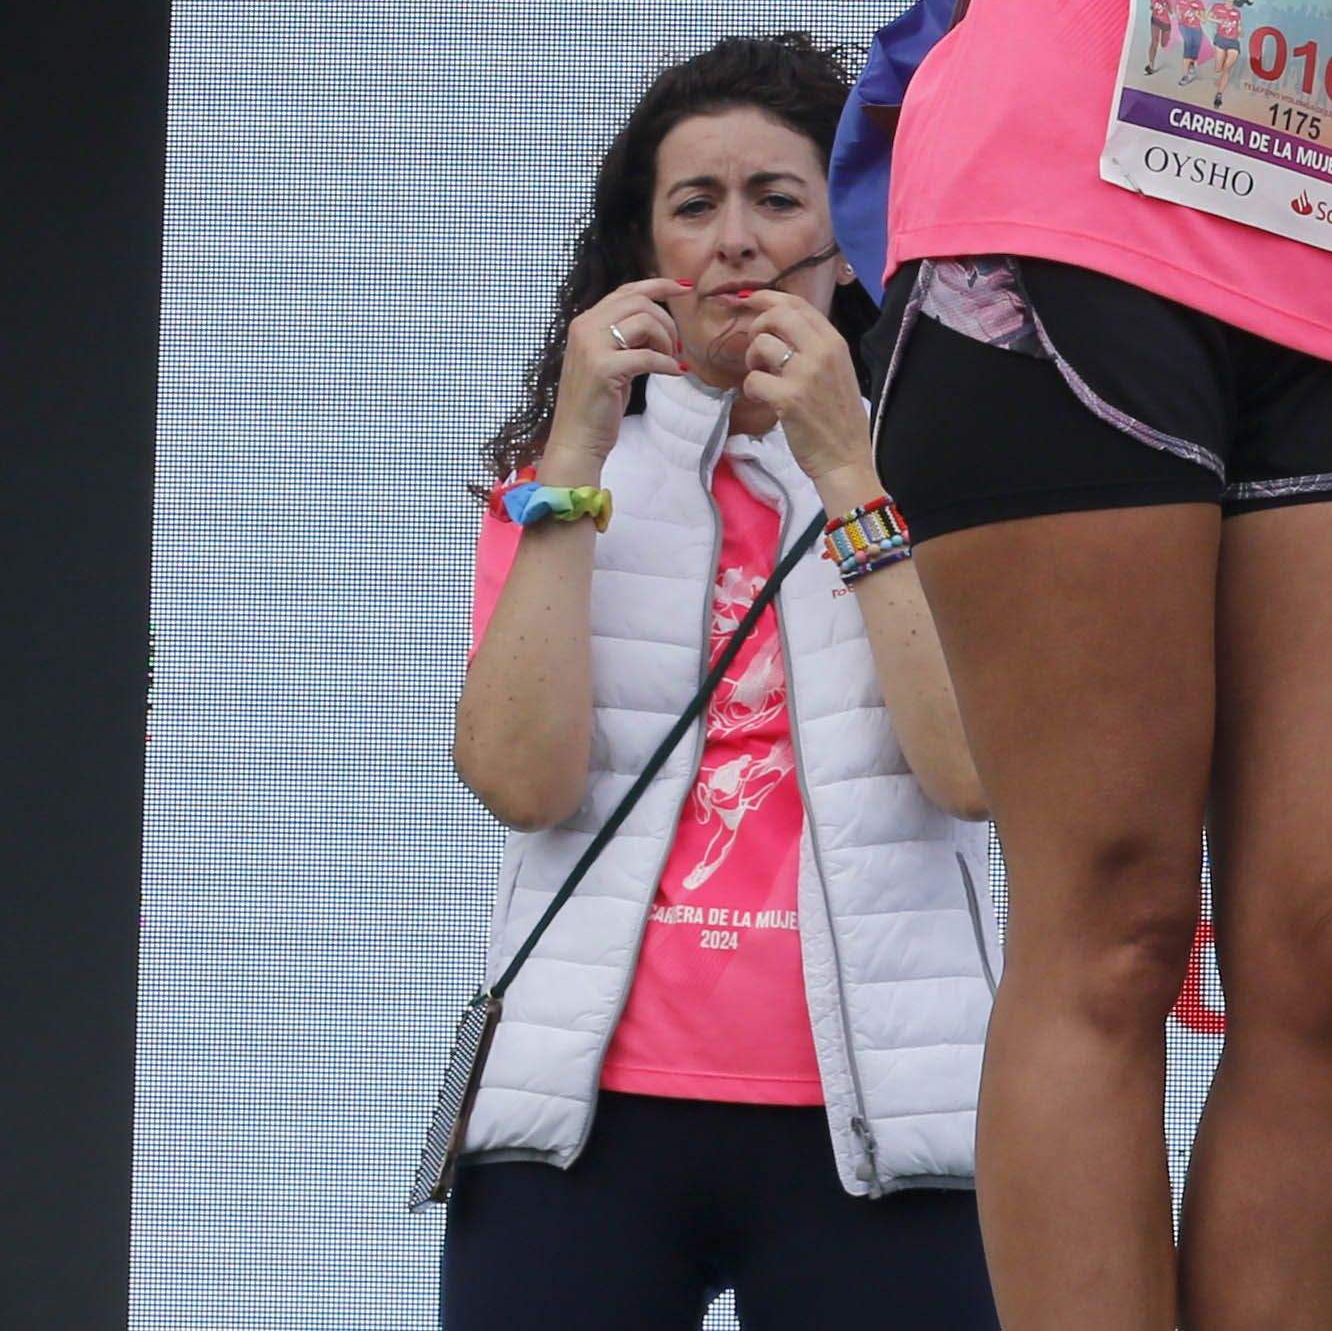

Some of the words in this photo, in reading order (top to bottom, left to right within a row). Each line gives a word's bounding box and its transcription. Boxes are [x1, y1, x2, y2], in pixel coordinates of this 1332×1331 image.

[1169, 108, 1245, 146] CARRERA
[1249, 132, 1269, 153] DE
[1273, 140, 1292, 160] LA
[1269, 103, 1321, 140] 1175
[1144, 146, 1254, 197] OYSHO
[707, 907, 729, 926] DE
[732, 910, 752, 928] LA
[755, 910, 798, 930] MUJE
[700, 929, 739, 950] 2024
